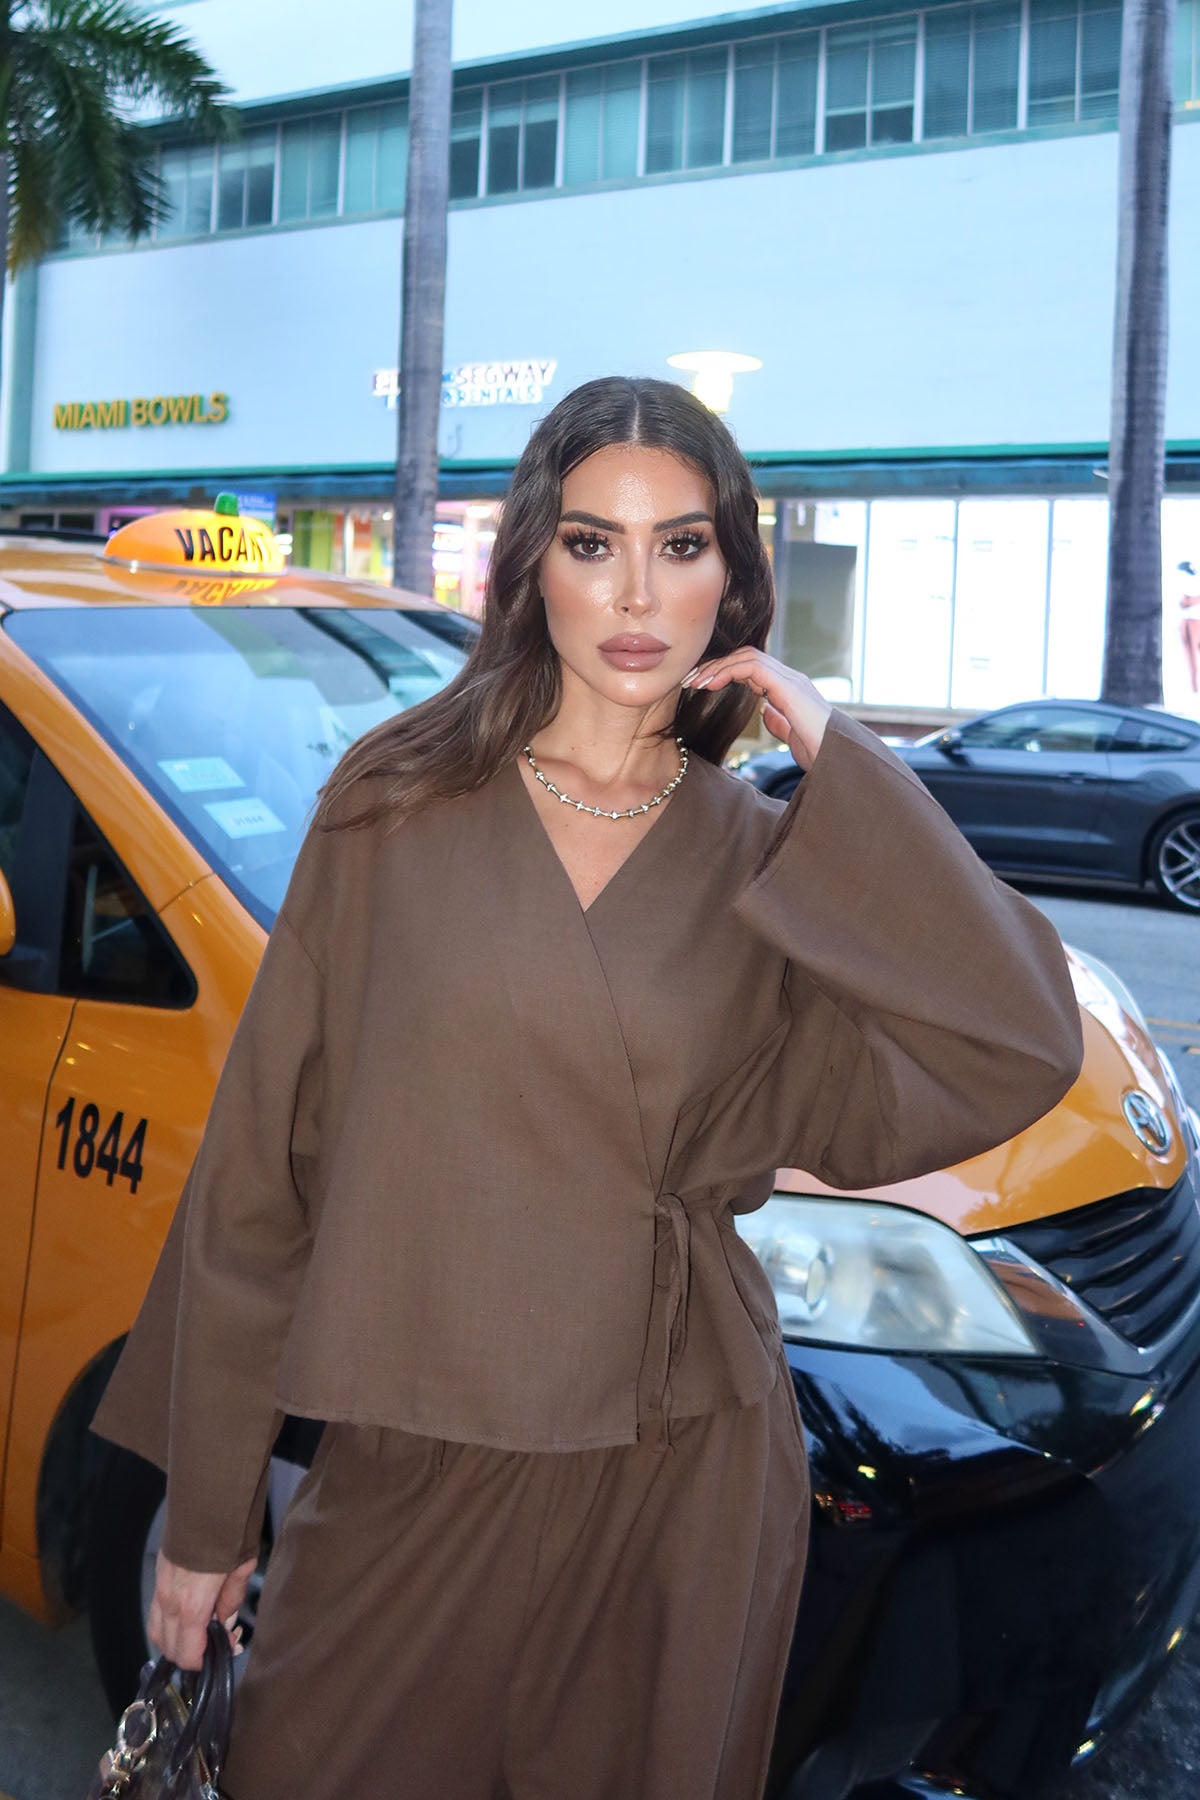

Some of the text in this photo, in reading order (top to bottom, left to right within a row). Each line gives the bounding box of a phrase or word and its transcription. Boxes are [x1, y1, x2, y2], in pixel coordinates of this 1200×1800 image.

[457, 360, 557, 387] SEGWAY
[457, 384, 542, 406] RENTALS
[54, 393, 229, 430] MIAMI BOWLS
[55, 1096, 148, 1195] 1844
